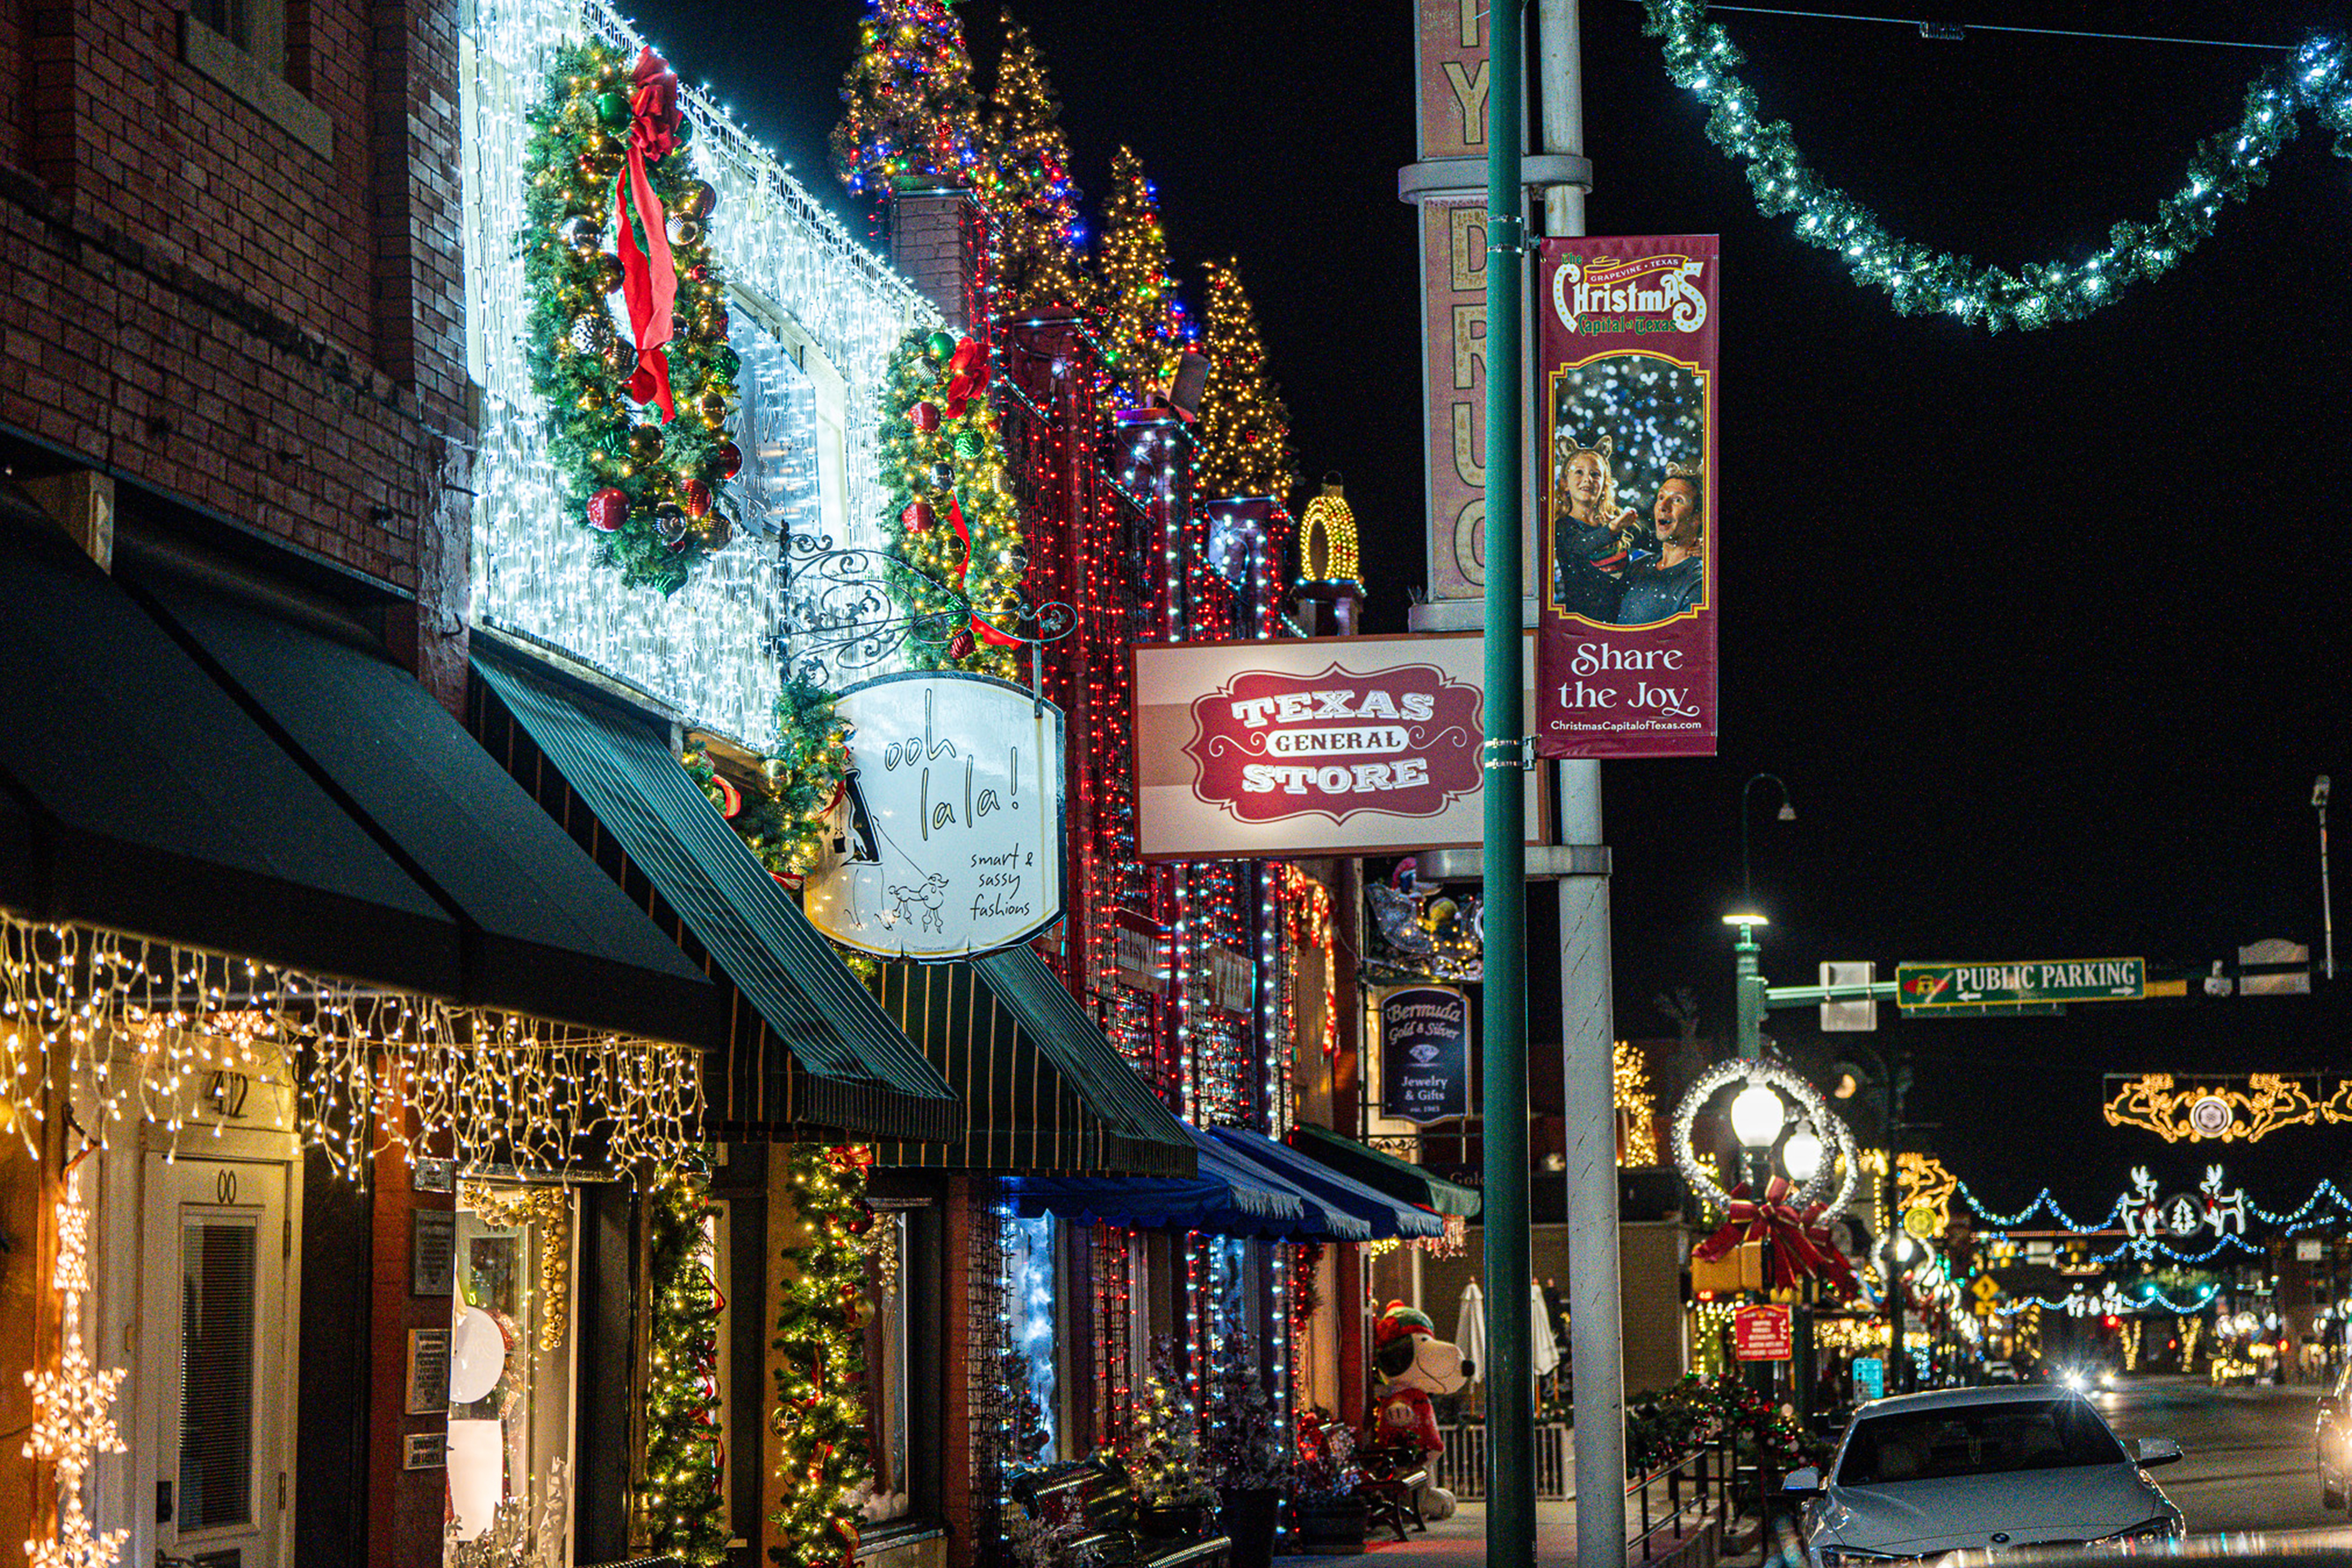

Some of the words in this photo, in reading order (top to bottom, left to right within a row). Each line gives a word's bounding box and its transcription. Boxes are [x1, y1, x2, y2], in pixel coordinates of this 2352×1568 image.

[1561, 253, 1582, 264] The
[1590, 265, 1642, 282] GRAPEVINE
[1651, 259, 1679, 267] TEXAS
[1578, 314, 1625, 336] Capital
[1635, 316, 1677, 335] Texas
[1571, 643, 1683, 676] Share
[1231, 690, 1434, 728] TEXAS
[1558, 681, 1617, 708] the
[1627, 682, 1700, 717] Joy
[885, 688, 956, 771] ooh
[1551, 720, 1702, 732] ChristmasCapitalofTexas.com
[1275, 732, 1401, 752] GENERAL
[1242, 758, 1429, 794] STORE
[921, 767, 955, 841] la
[971, 843, 1019, 869] smart
[1025, 851, 1034, 867] &
[979, 875, 1020, 899] sassy
[970, 893, 1030, 920] fashions
[1956, 965, 2035, 992] PUBLIC
[2042, 962, 2136, 989] PARKING
[1387, 1002, 1461, 1023] Bermuda
[1388, 1021, 1417, 1045] Gold
[1416, 1022, 1424, 1034] &
[1425, 1022, 1460, 1040] Silver
[1402, 1075, 1448, 1090] Jewelry
[1405, 1090, 1414, 1100] &
[1417, 1089, 1445, 1101] Gifts
